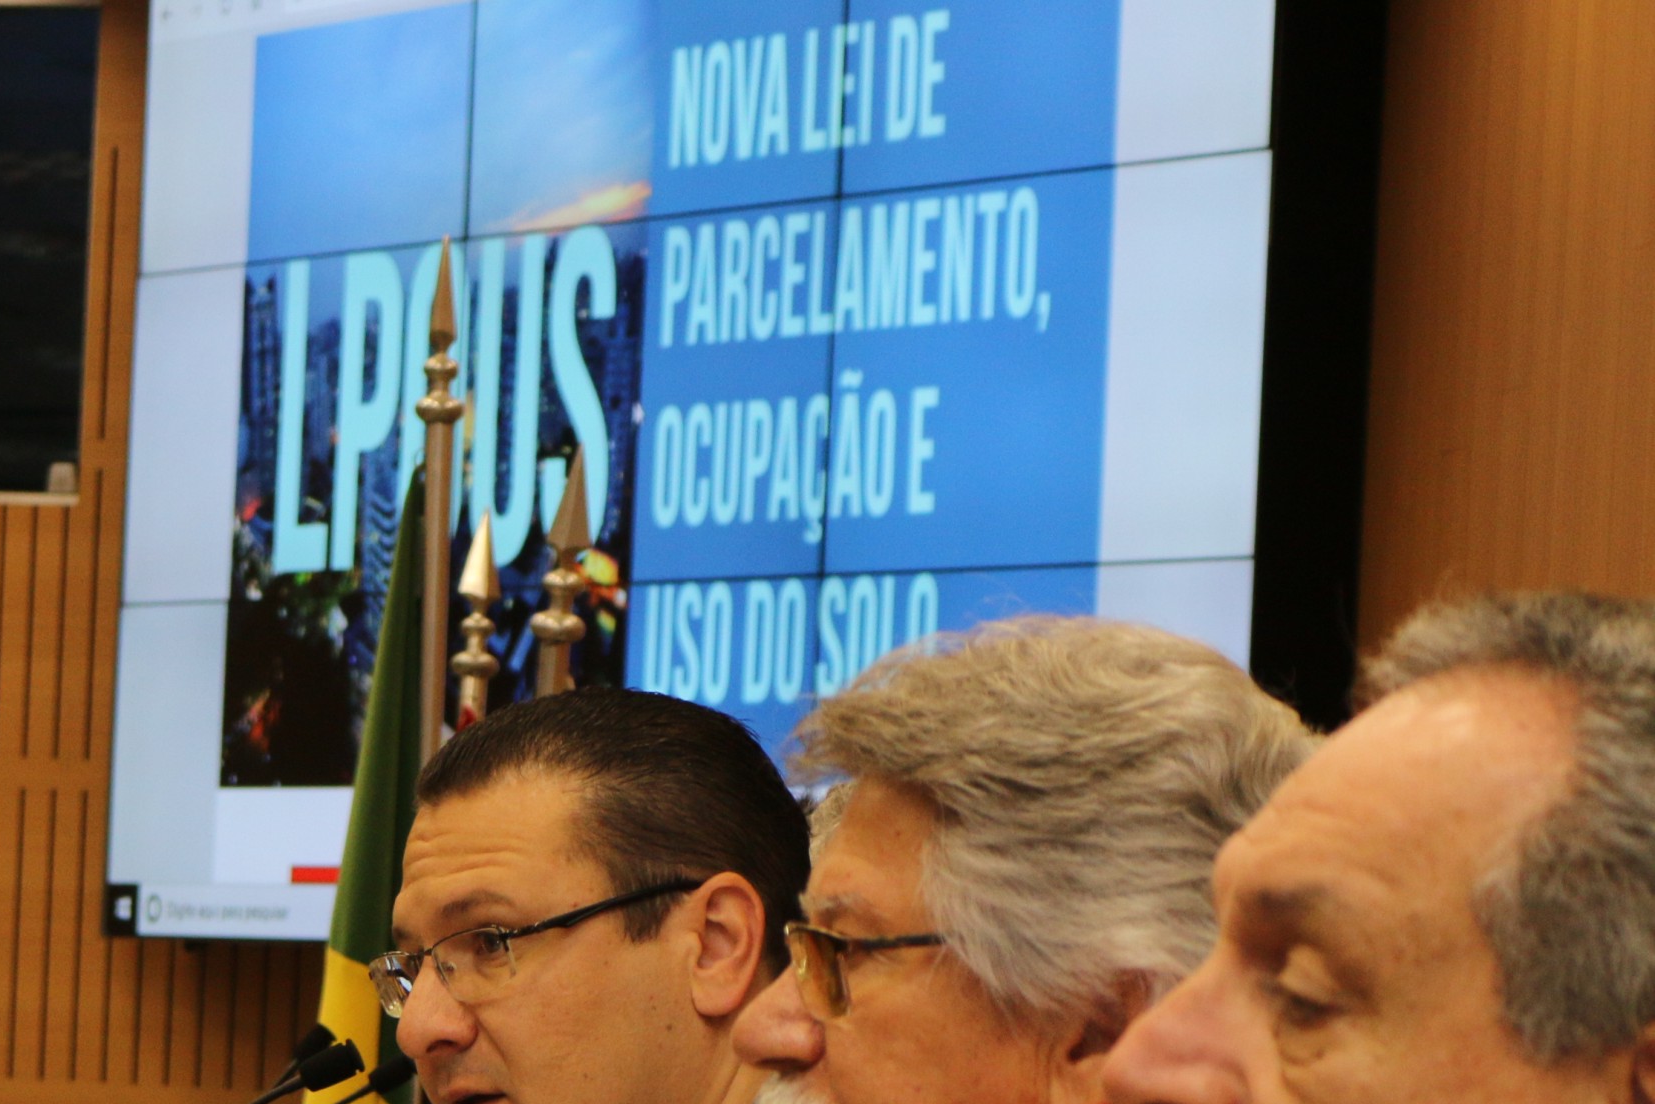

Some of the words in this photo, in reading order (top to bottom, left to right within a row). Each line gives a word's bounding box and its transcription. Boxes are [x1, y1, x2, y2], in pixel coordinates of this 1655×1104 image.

[668, 31, 790, 169] NOVA
[800, 19, 877, 153] LEI
[885, 8, 951, 142] DE
[659, 186, 1052, 348] PARCELAMENTO,
[651, 368, 897, 544] OCUPAÇÃO
[906, 385, 940, 515] E
[643, 580, 733, 706] USO
[741, 576, 807, 706] DO
